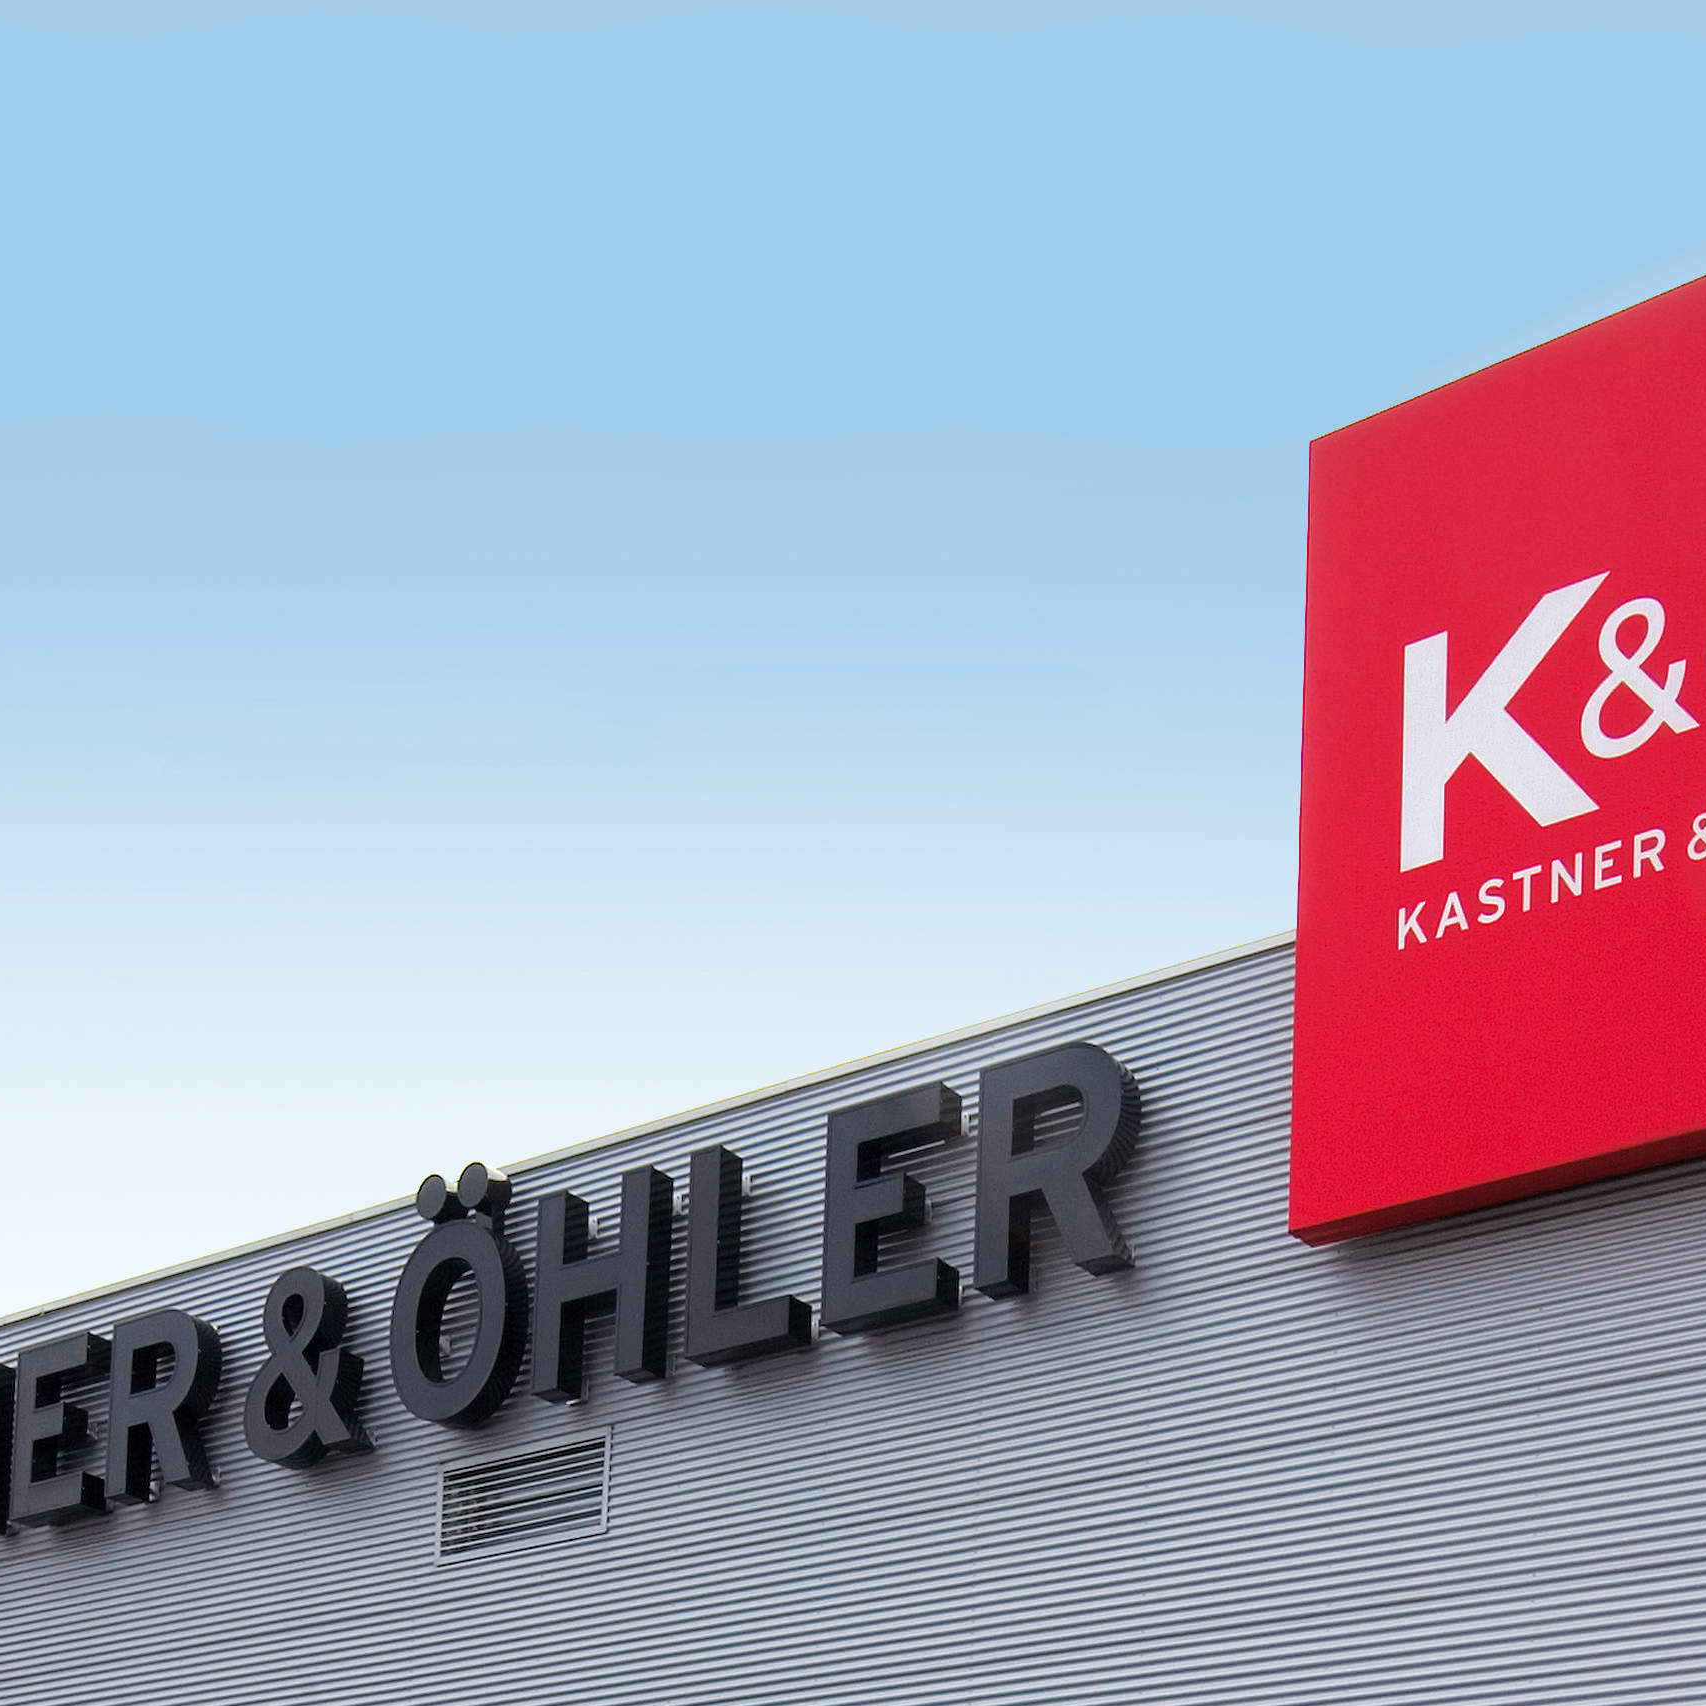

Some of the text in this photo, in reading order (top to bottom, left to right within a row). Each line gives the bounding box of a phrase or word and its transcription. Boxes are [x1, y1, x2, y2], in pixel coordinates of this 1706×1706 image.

[1397, 829, 1666, 950] KASTNER
[244, 1266, 365, 1468] &
[390, 1041, 1141, 1428] ÖHLER
